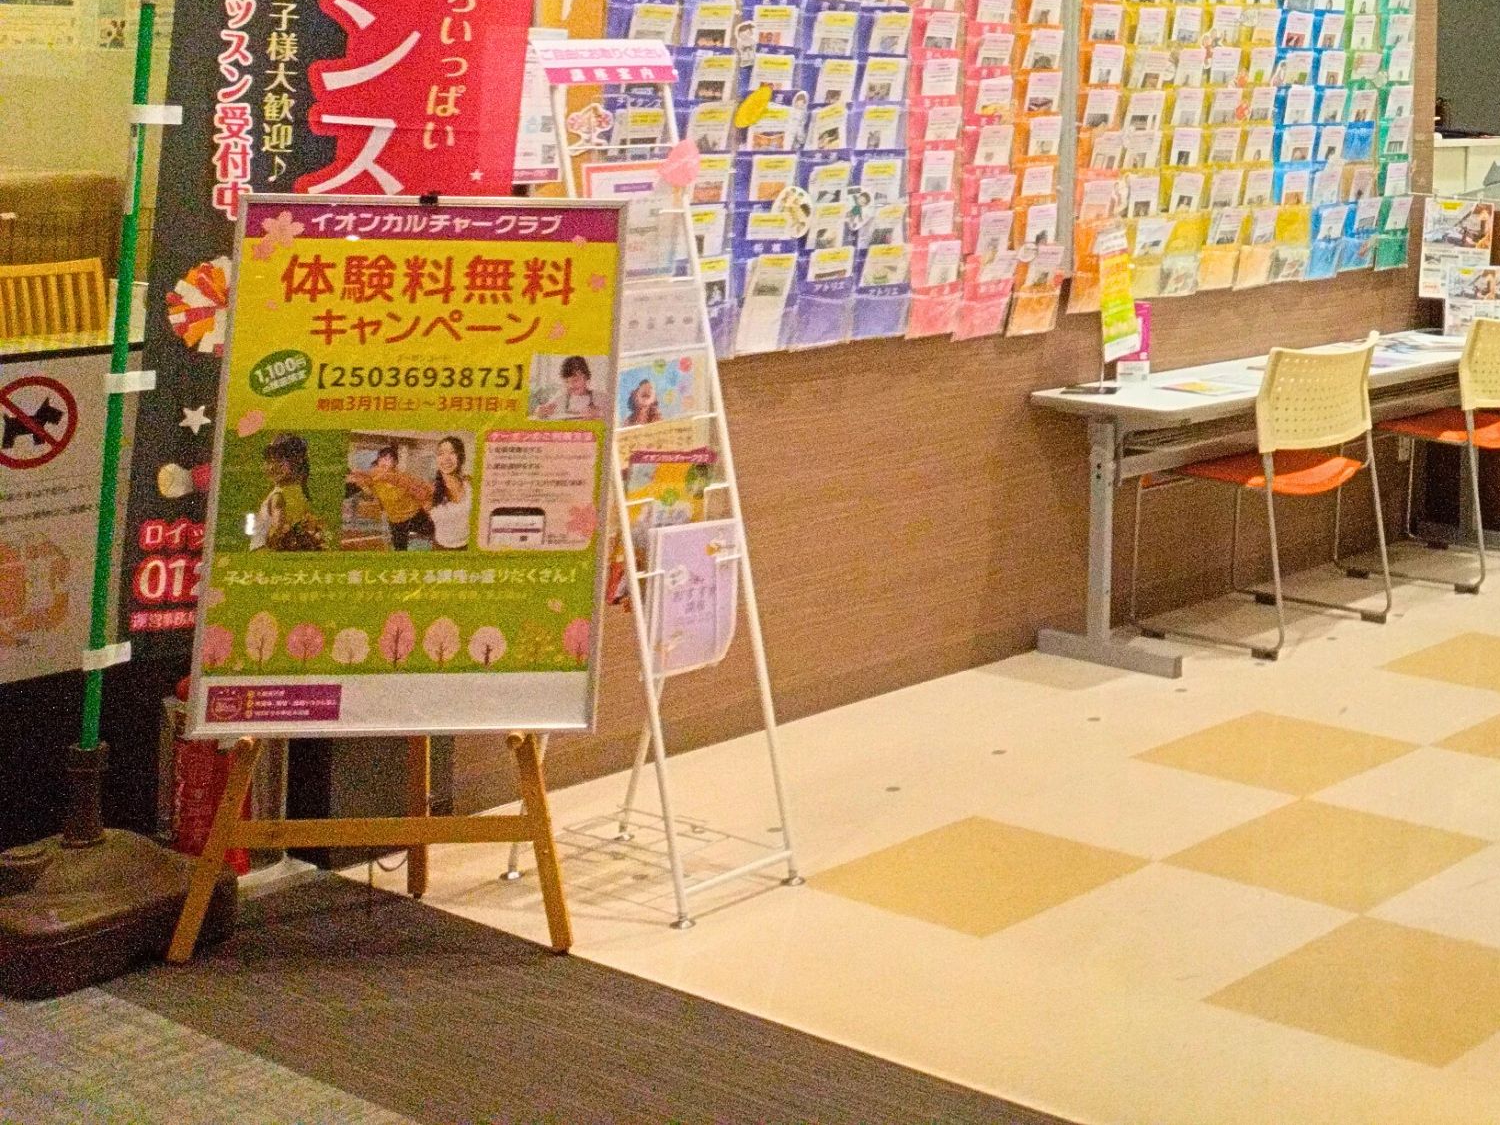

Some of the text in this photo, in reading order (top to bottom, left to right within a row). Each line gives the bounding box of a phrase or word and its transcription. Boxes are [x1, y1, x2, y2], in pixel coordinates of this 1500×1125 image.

[310, 211, 564, 236] イオンカルチャークラブ
[280, 254, 576, 307] 体験料無料
[310, 308, 543, 346] キャンペーン
